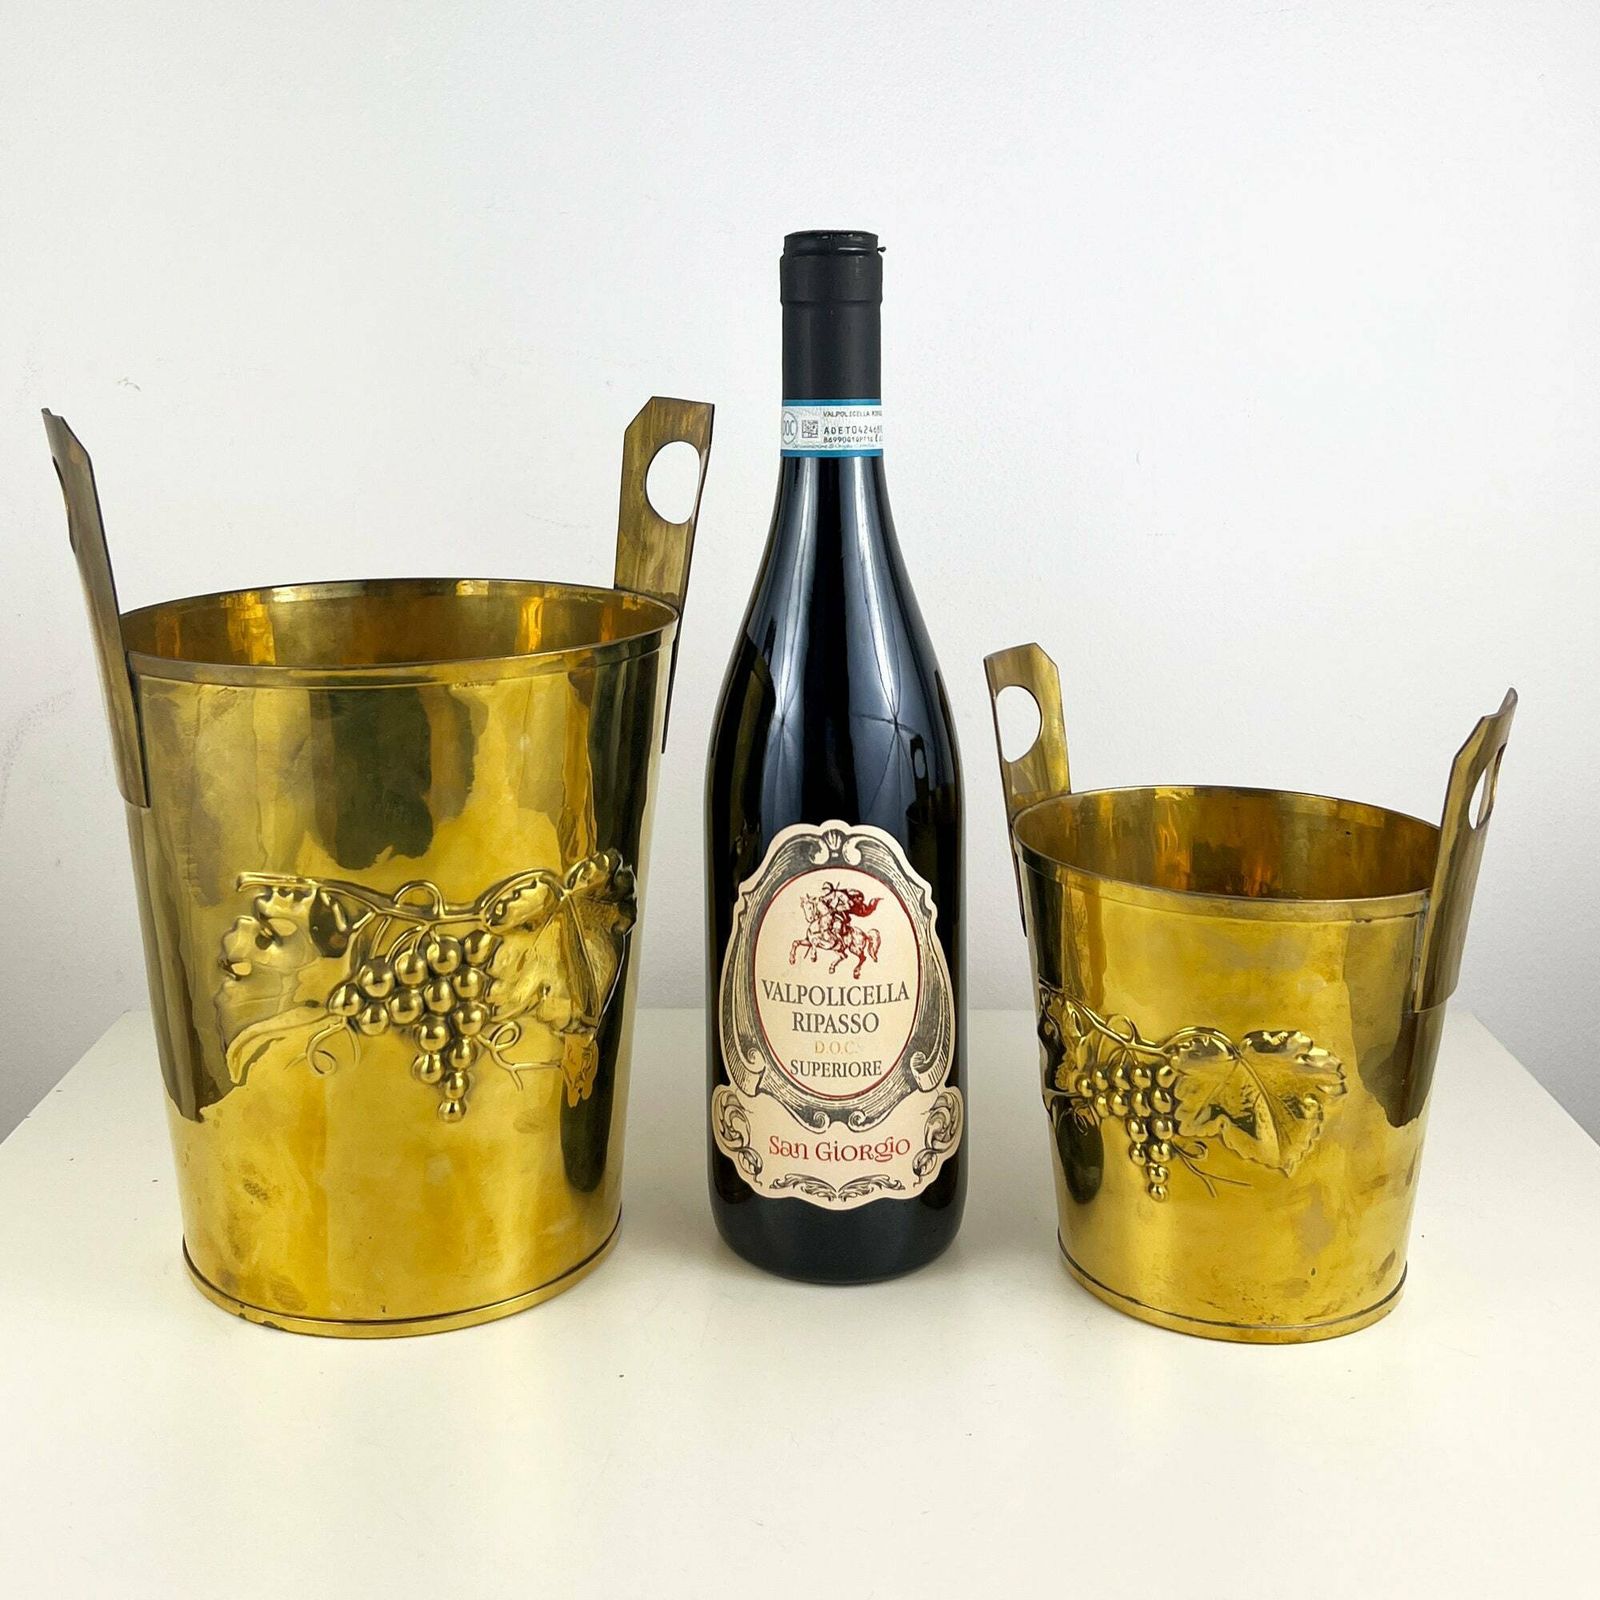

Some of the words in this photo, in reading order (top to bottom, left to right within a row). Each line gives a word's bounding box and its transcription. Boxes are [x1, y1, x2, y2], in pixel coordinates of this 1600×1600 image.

[761, 979, 910, 1007] VALPOLICELLA
[792, 1012, 879, 1034] RIPASSO
[790, 1060, 882, 1078] SUPERIORE
[769, 1135, 810, 1160] San
[815, 1136, 911, 1162] Giorgio
